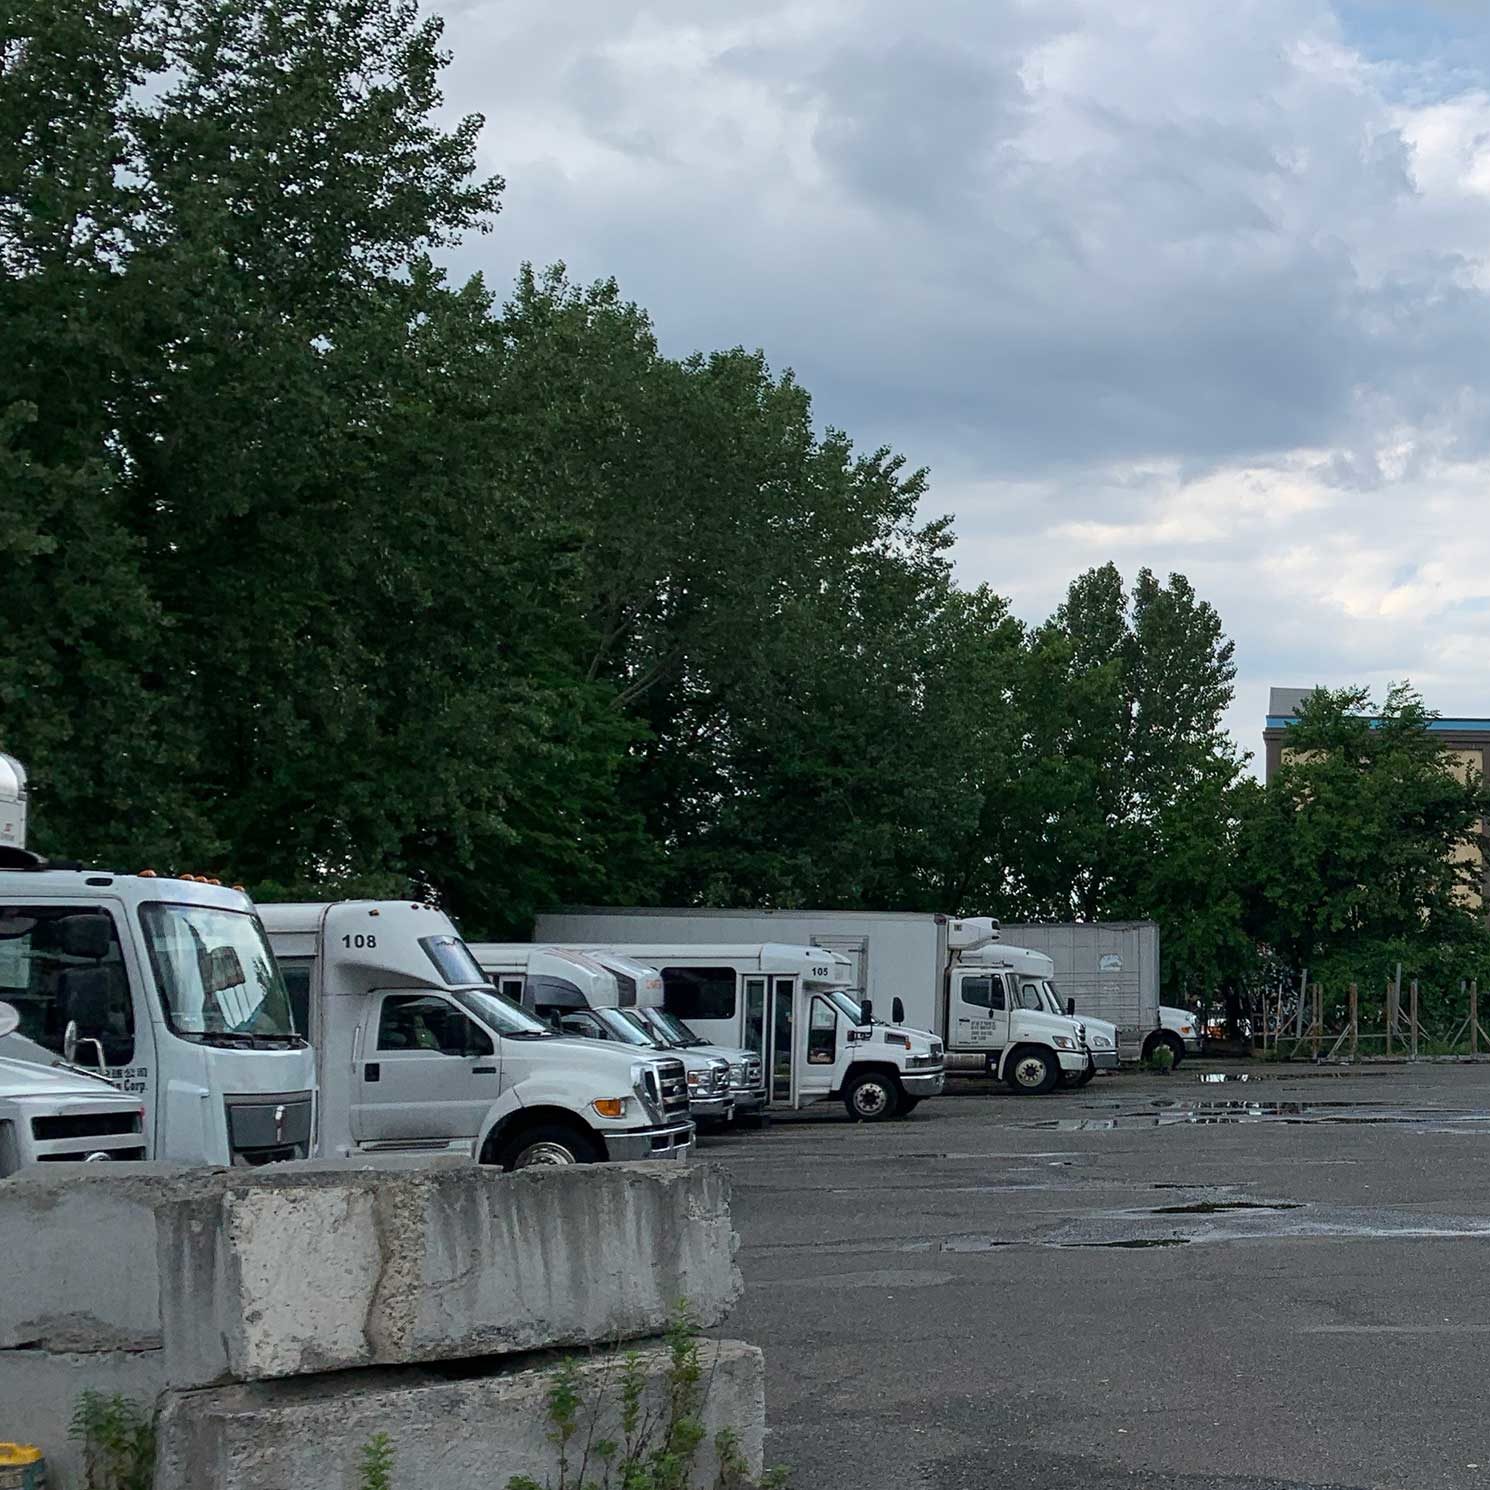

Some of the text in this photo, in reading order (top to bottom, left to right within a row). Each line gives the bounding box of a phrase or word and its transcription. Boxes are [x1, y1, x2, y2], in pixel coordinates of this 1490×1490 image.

[342, 934, 377, 949] 108
[812, 967, 828, 976] 105
[124, 1079, 148, 1094] Corp.
